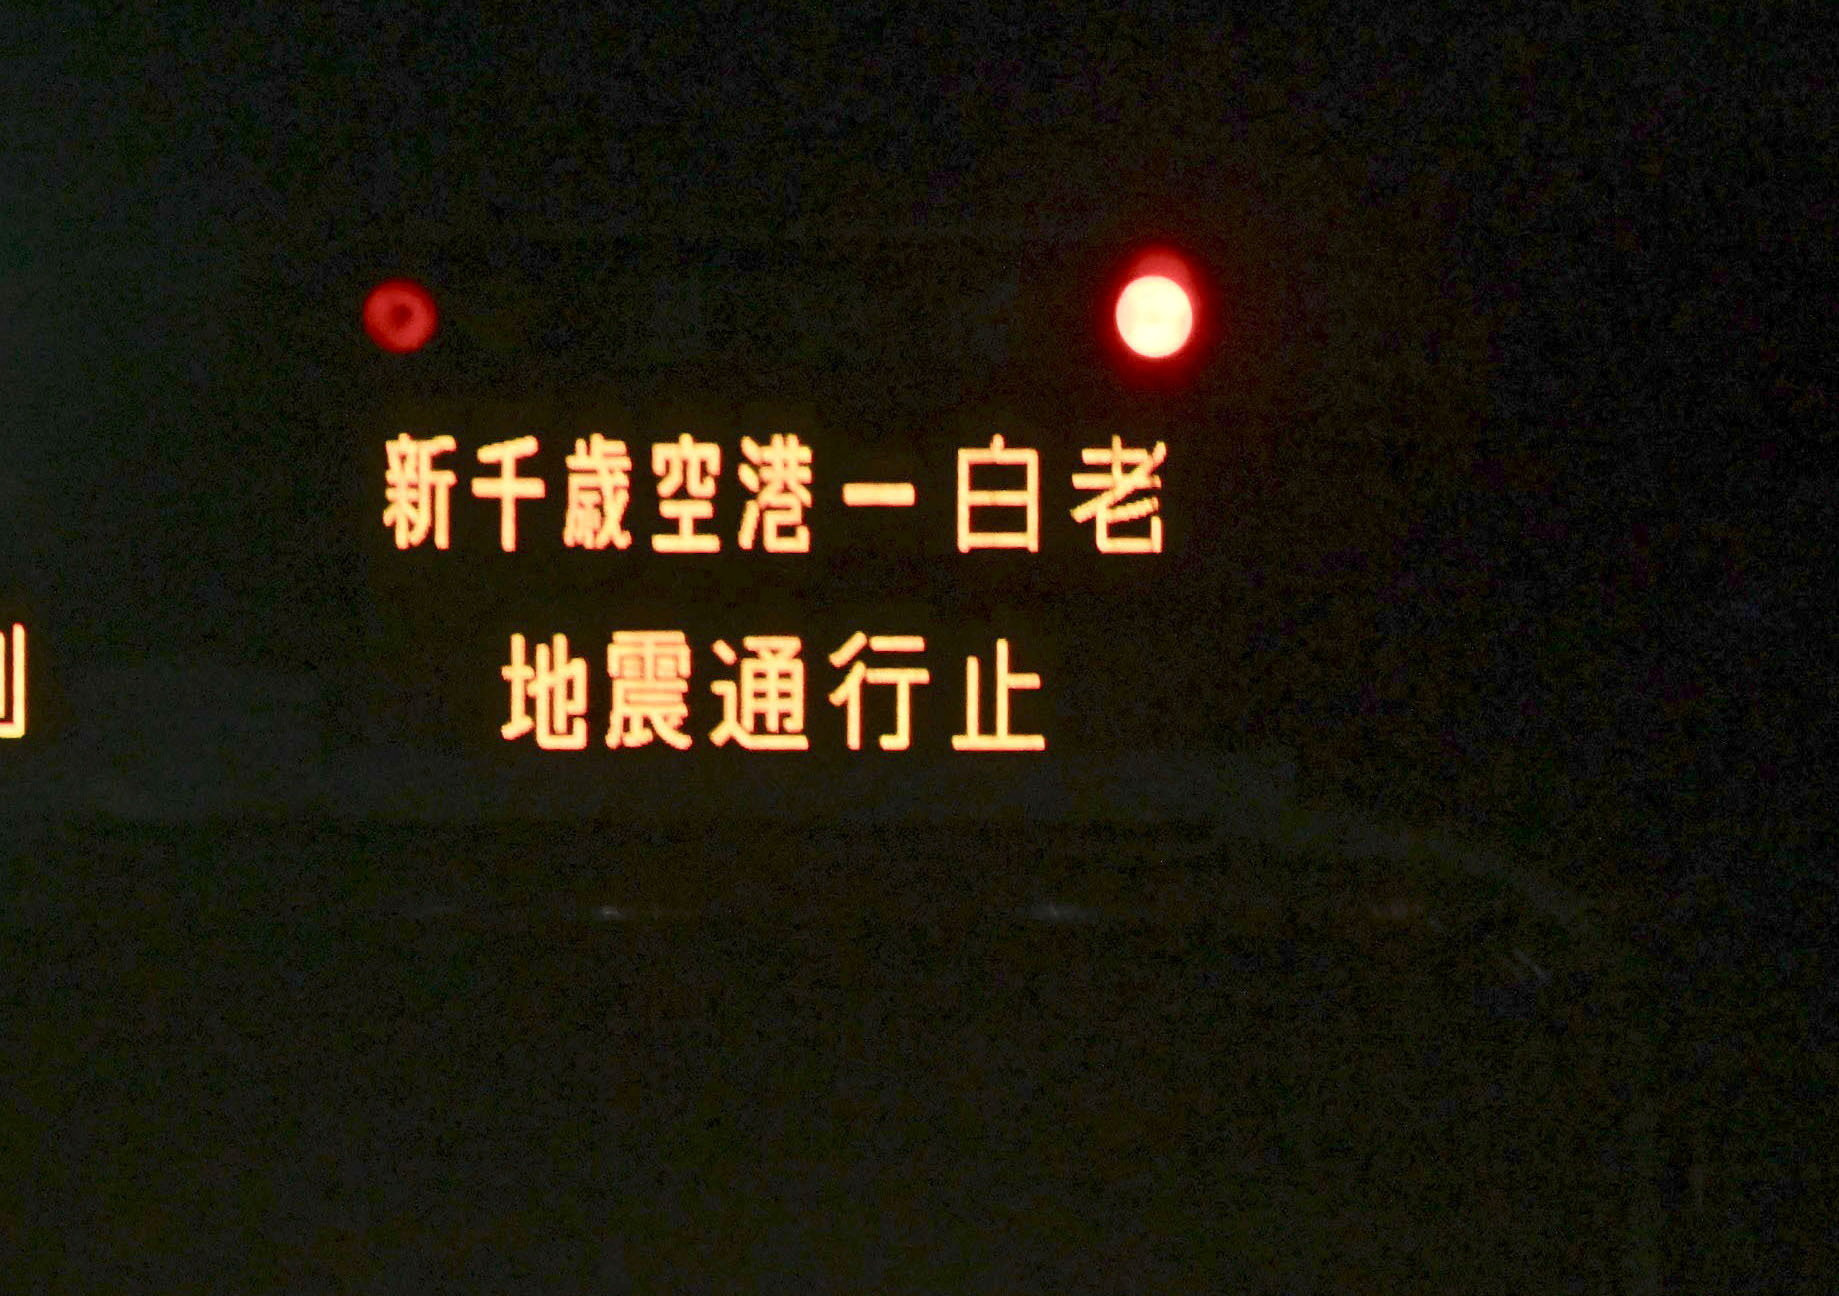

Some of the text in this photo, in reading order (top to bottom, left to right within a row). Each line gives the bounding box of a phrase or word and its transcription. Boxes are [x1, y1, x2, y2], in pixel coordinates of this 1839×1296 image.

[500, 629, 1047, 753] 地震通行止
